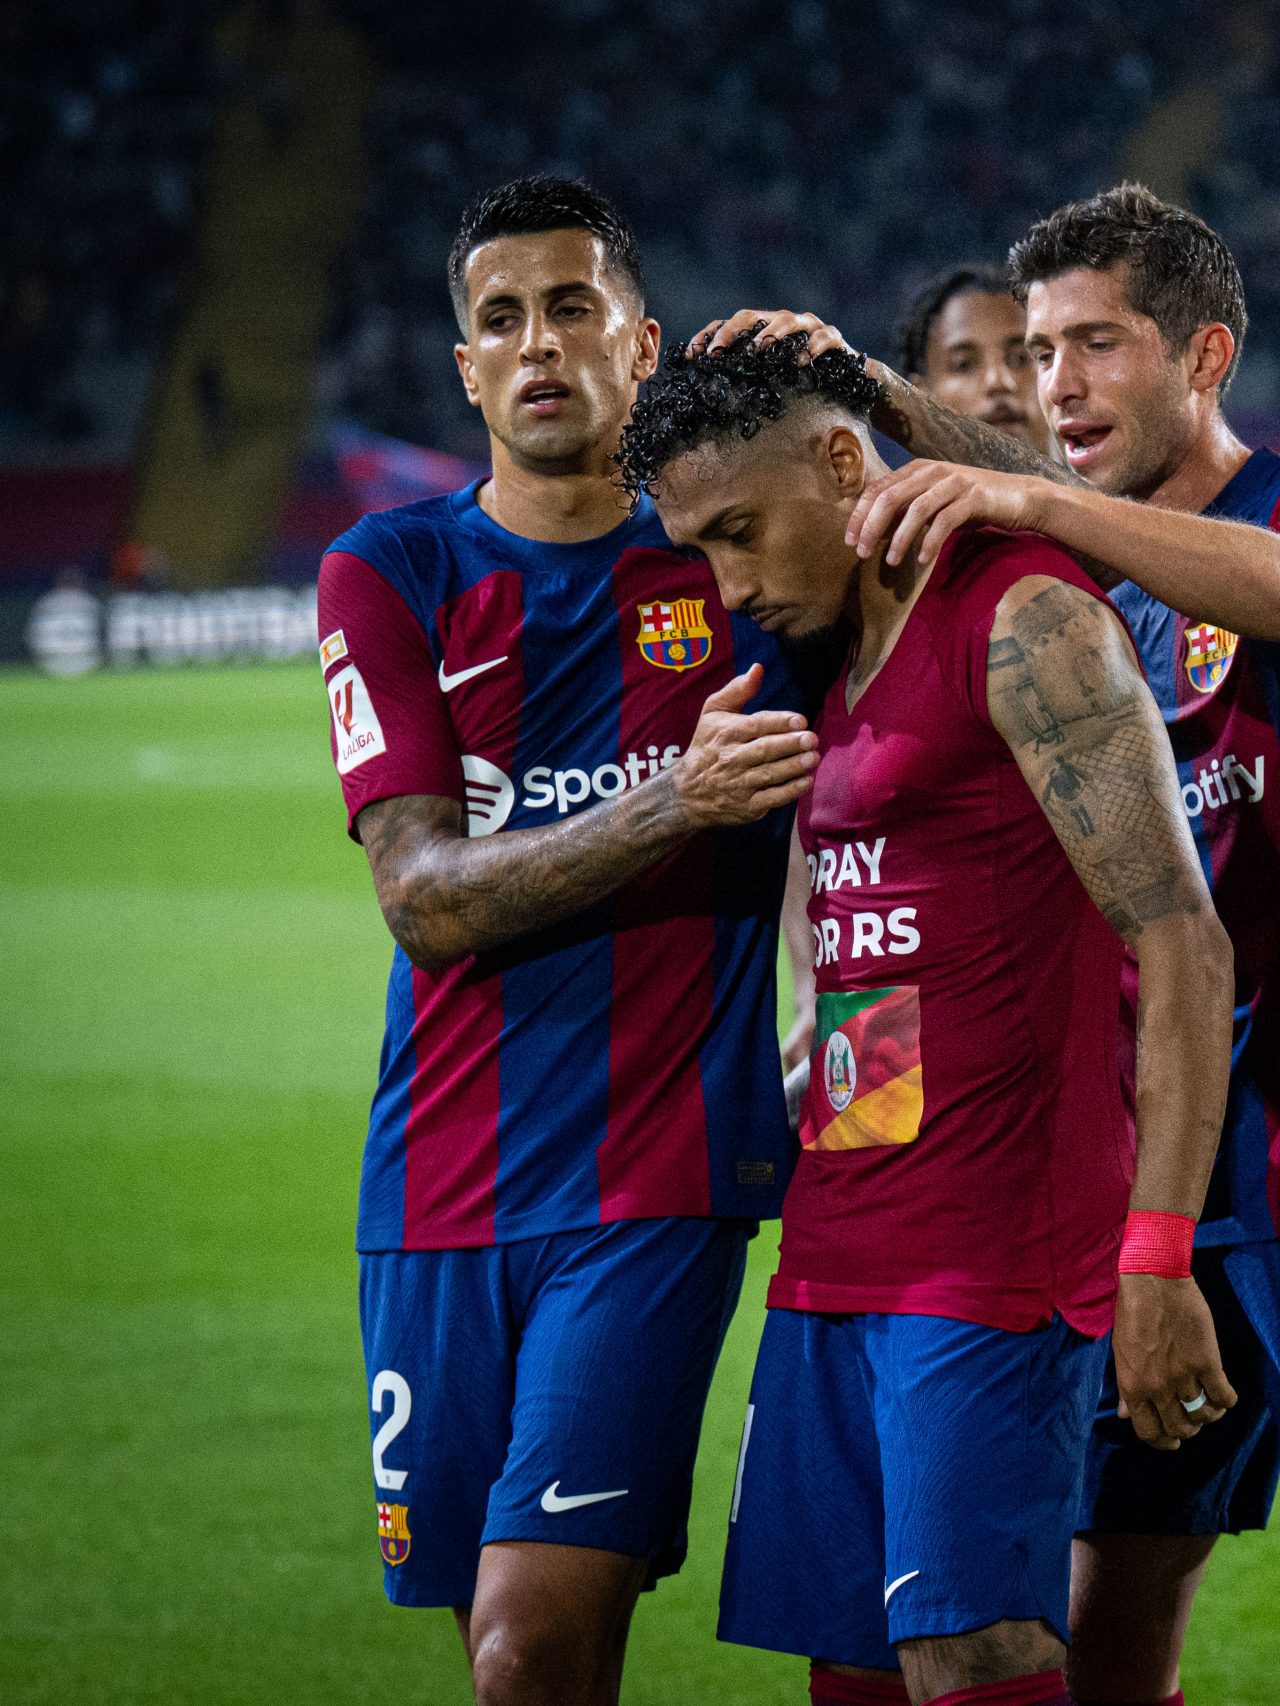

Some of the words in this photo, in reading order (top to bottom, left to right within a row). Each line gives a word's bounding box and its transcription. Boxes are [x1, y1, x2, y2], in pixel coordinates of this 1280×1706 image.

[659, 628, 689, 640] FCB
[342, 731, 376, 760] LALIGA
[522, 744, 682, 814] Spotif
[1181, 754, 1265, 818] otify
[812, 917, 840, 969] OR
[851, 906, 921, 959] RS
[371, 1369, 412, 1491] 2
